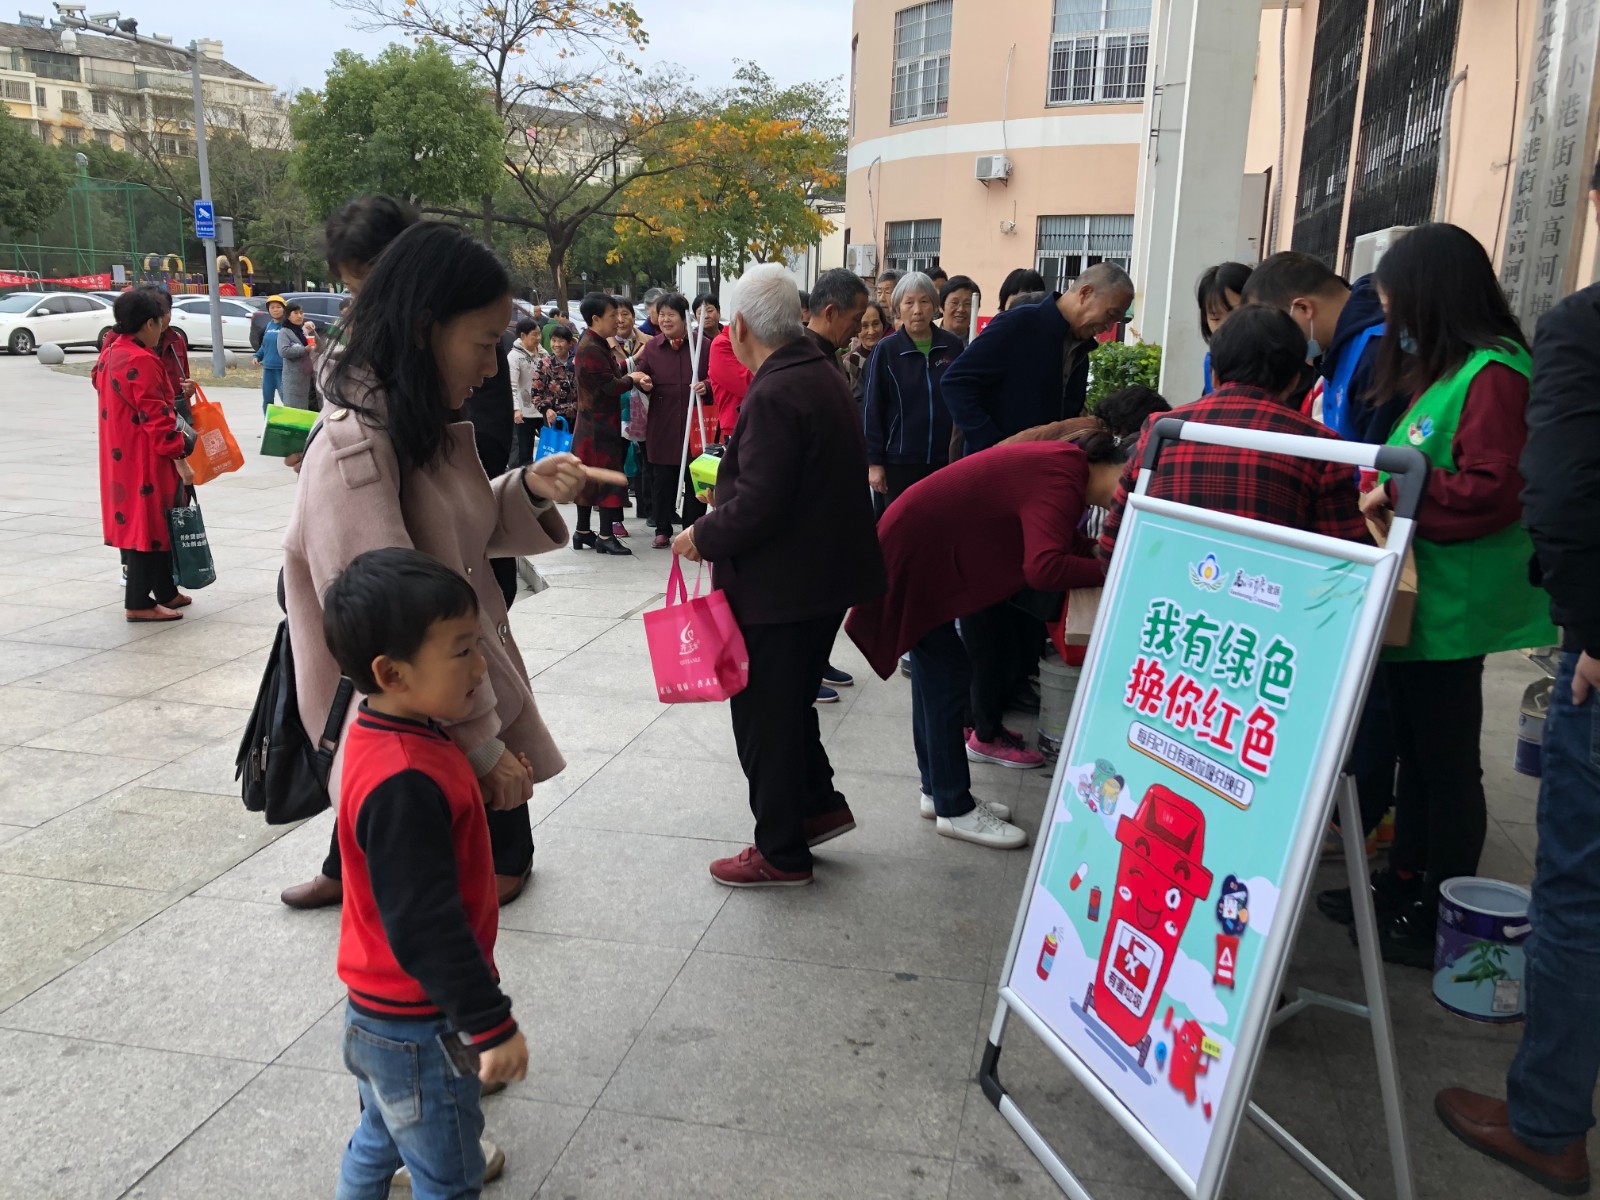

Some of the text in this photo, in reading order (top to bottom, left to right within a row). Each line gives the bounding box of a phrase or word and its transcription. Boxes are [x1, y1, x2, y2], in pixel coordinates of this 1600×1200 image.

[1141, 601, 1295, 705] 我有绿色
[1126, 657, 1276, 773] 换你红色
[1137, 728, 1246, 799] 每月21日有害垃圾兑换日
[1108, 970, 1142, 1010] 有害垃圾
